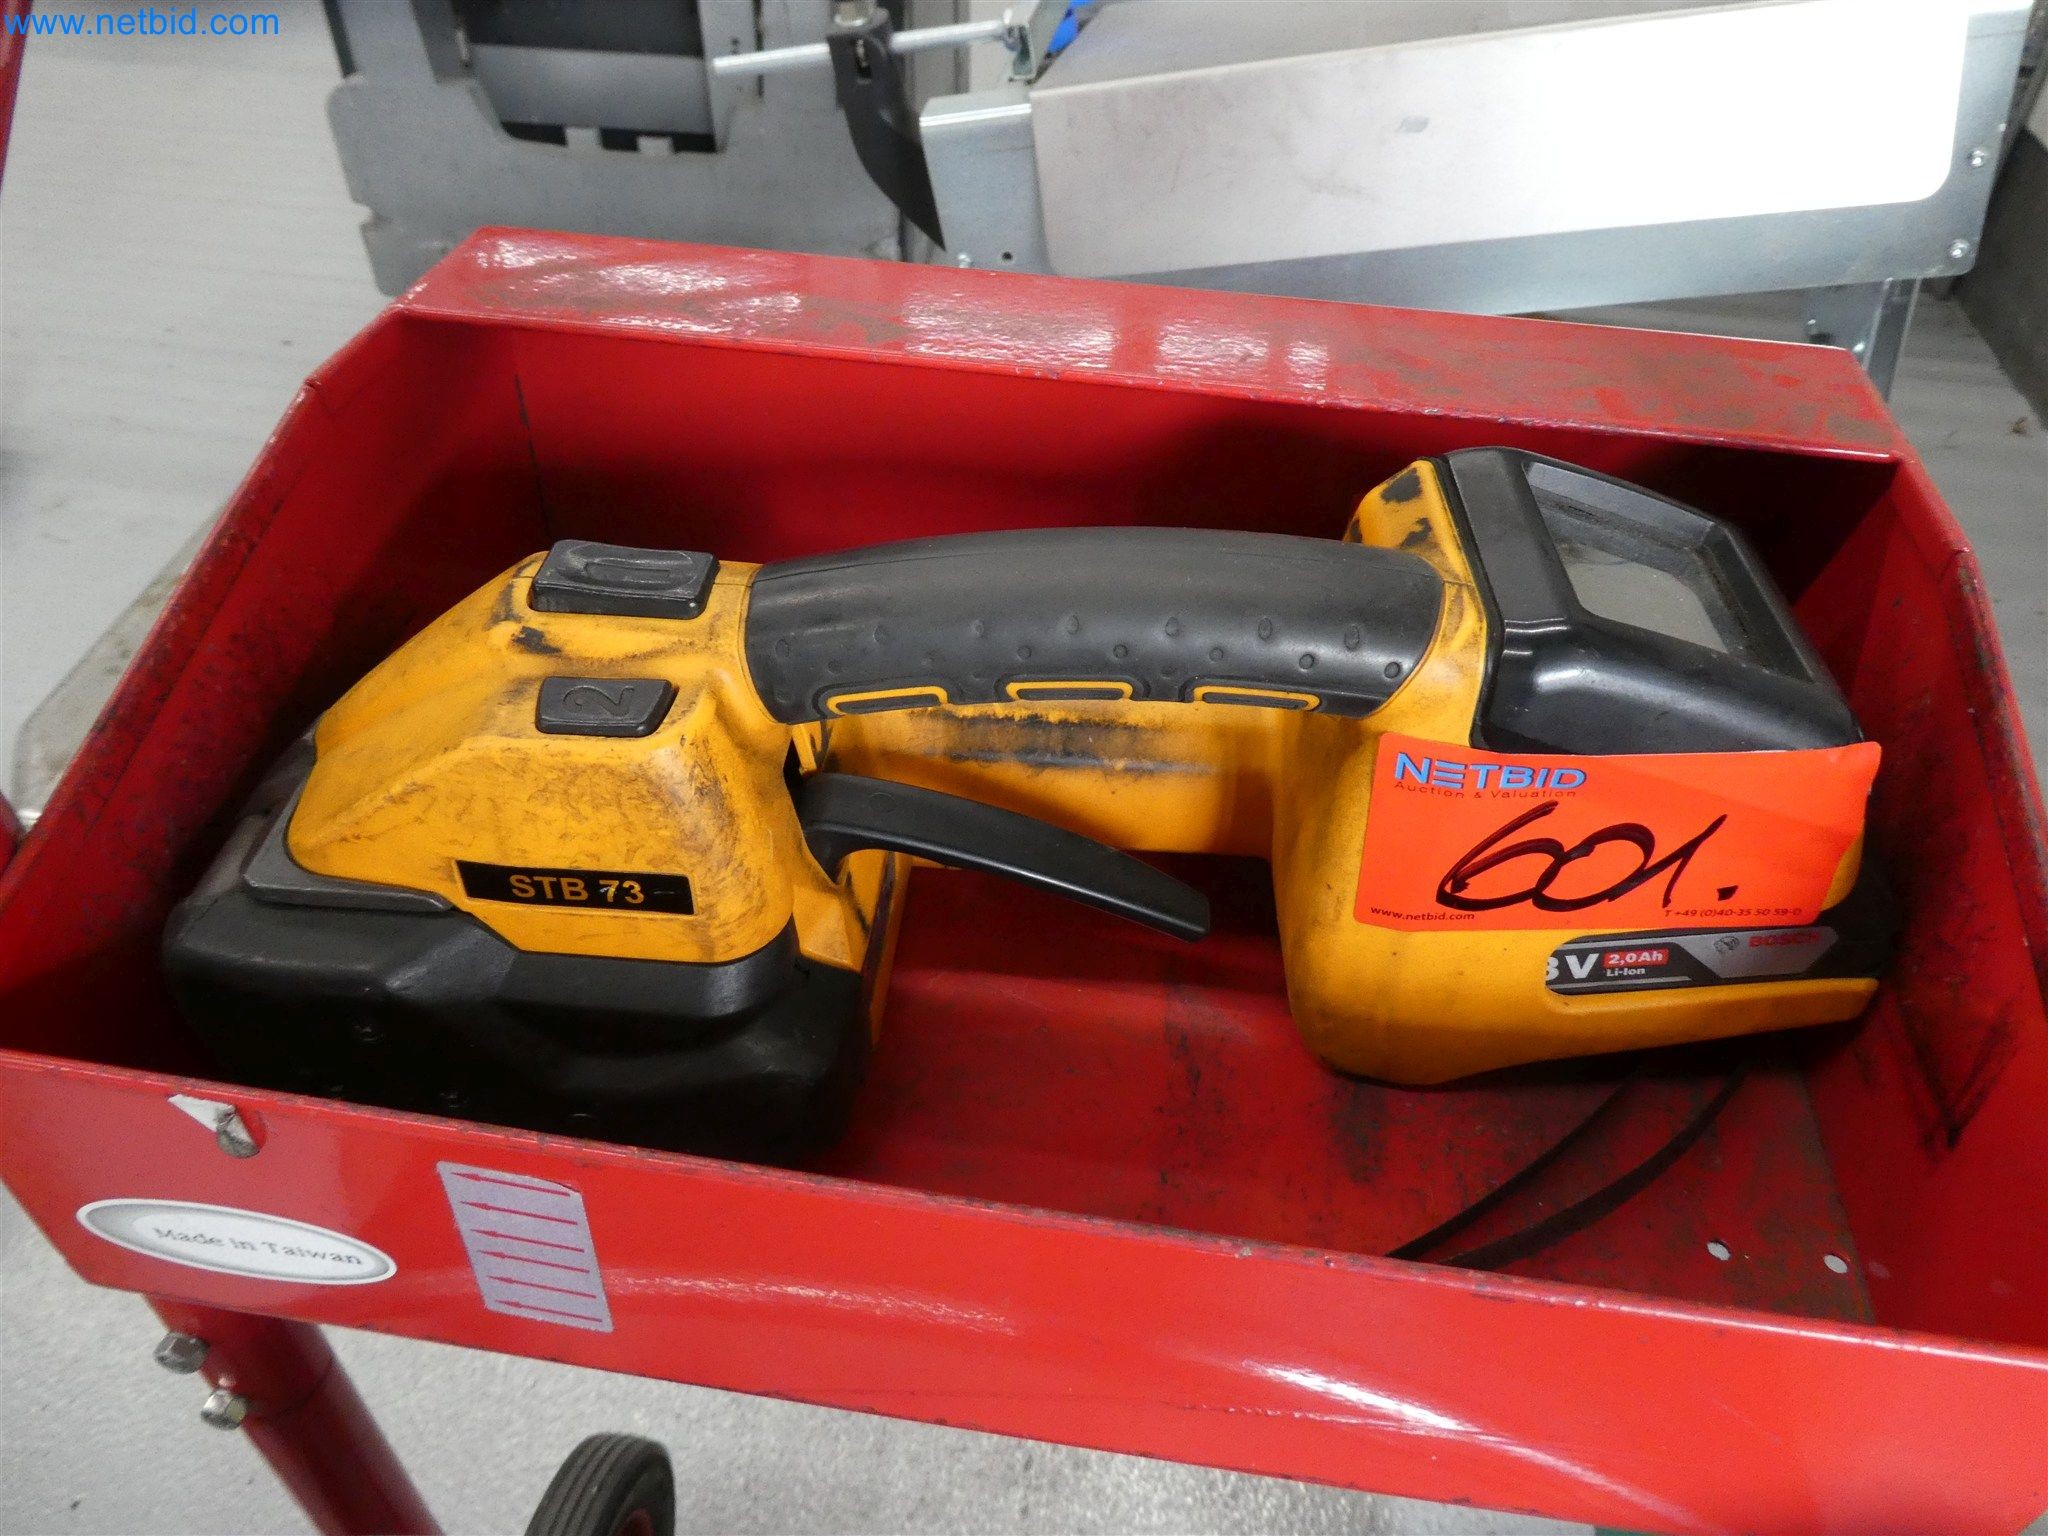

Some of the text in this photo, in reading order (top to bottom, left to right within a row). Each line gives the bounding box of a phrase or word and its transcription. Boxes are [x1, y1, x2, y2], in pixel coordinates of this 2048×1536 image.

[1395, 752, 1587, 789] NETBID
[1394, 781, 1576, 799] Auction & Valuation
[509, 874, 645, 904] STB 73
[1370, 906, 1475, 921] www.netbid.com
[1608, 950, 1664, 965] 2,0Ah
[153, 1227, 362, 1265] Made in Taiwan
